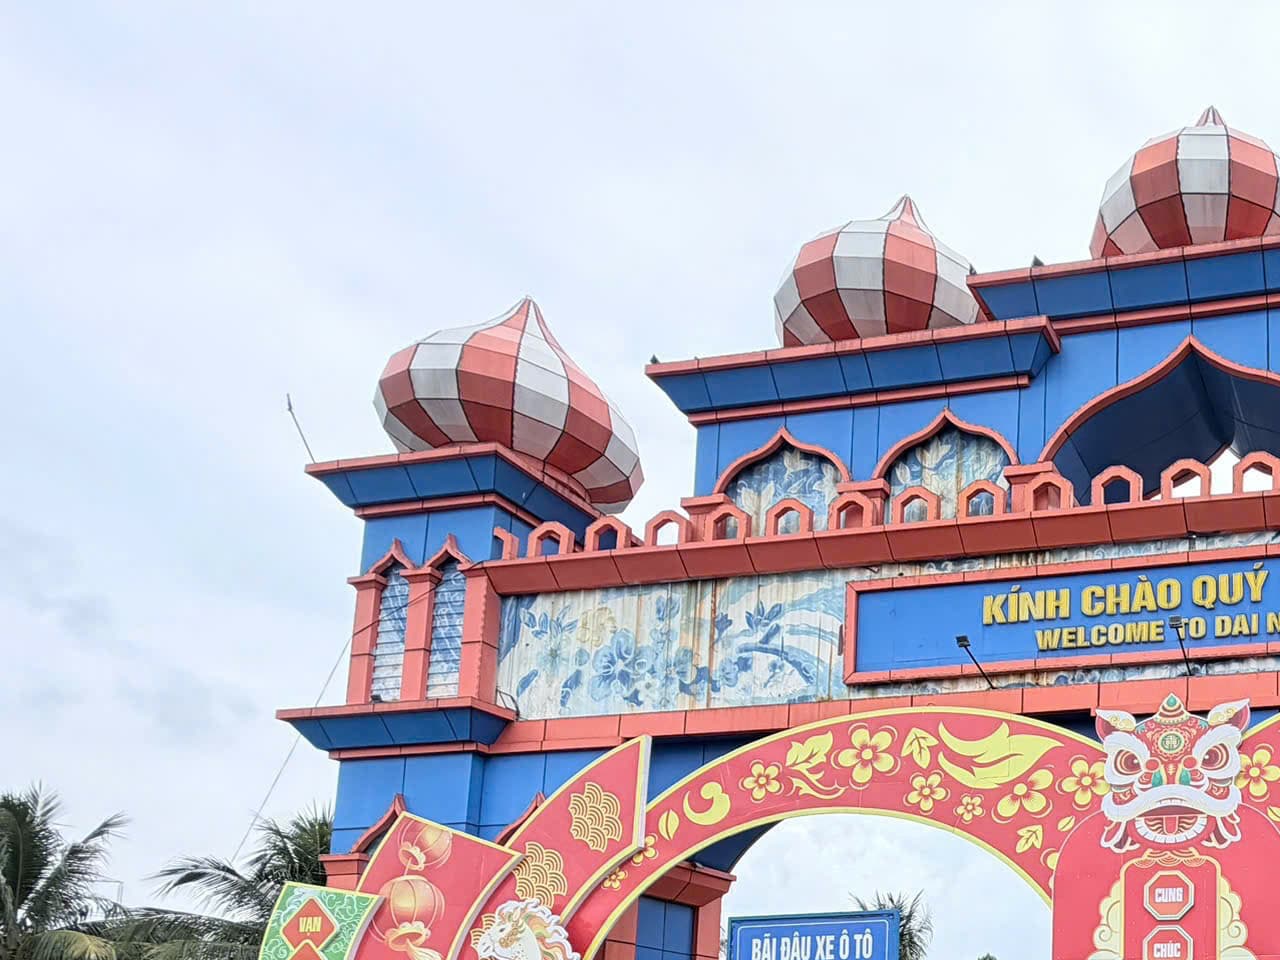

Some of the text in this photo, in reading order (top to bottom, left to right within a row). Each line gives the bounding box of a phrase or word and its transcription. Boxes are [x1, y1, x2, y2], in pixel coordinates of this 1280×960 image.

[982, 585, 1070, 625] KÍNH
[1080, 575, 1182, 617] CHÀO
[1192, 562, 1269, 609] QUÝ
[1035, 619, 1165, 651] WELCOME
[1214, 612, 1259, 638] DAI
[1154, 887, 1183, 903] CUNG
[299, 916, 321, 936] VẠN
[815, 934, 835, 960] XE
[839, 929, 850, 960] Ô
[854, 928, 873, 960] TÔ
[1153, 941, 1181, 958] CHÚC
